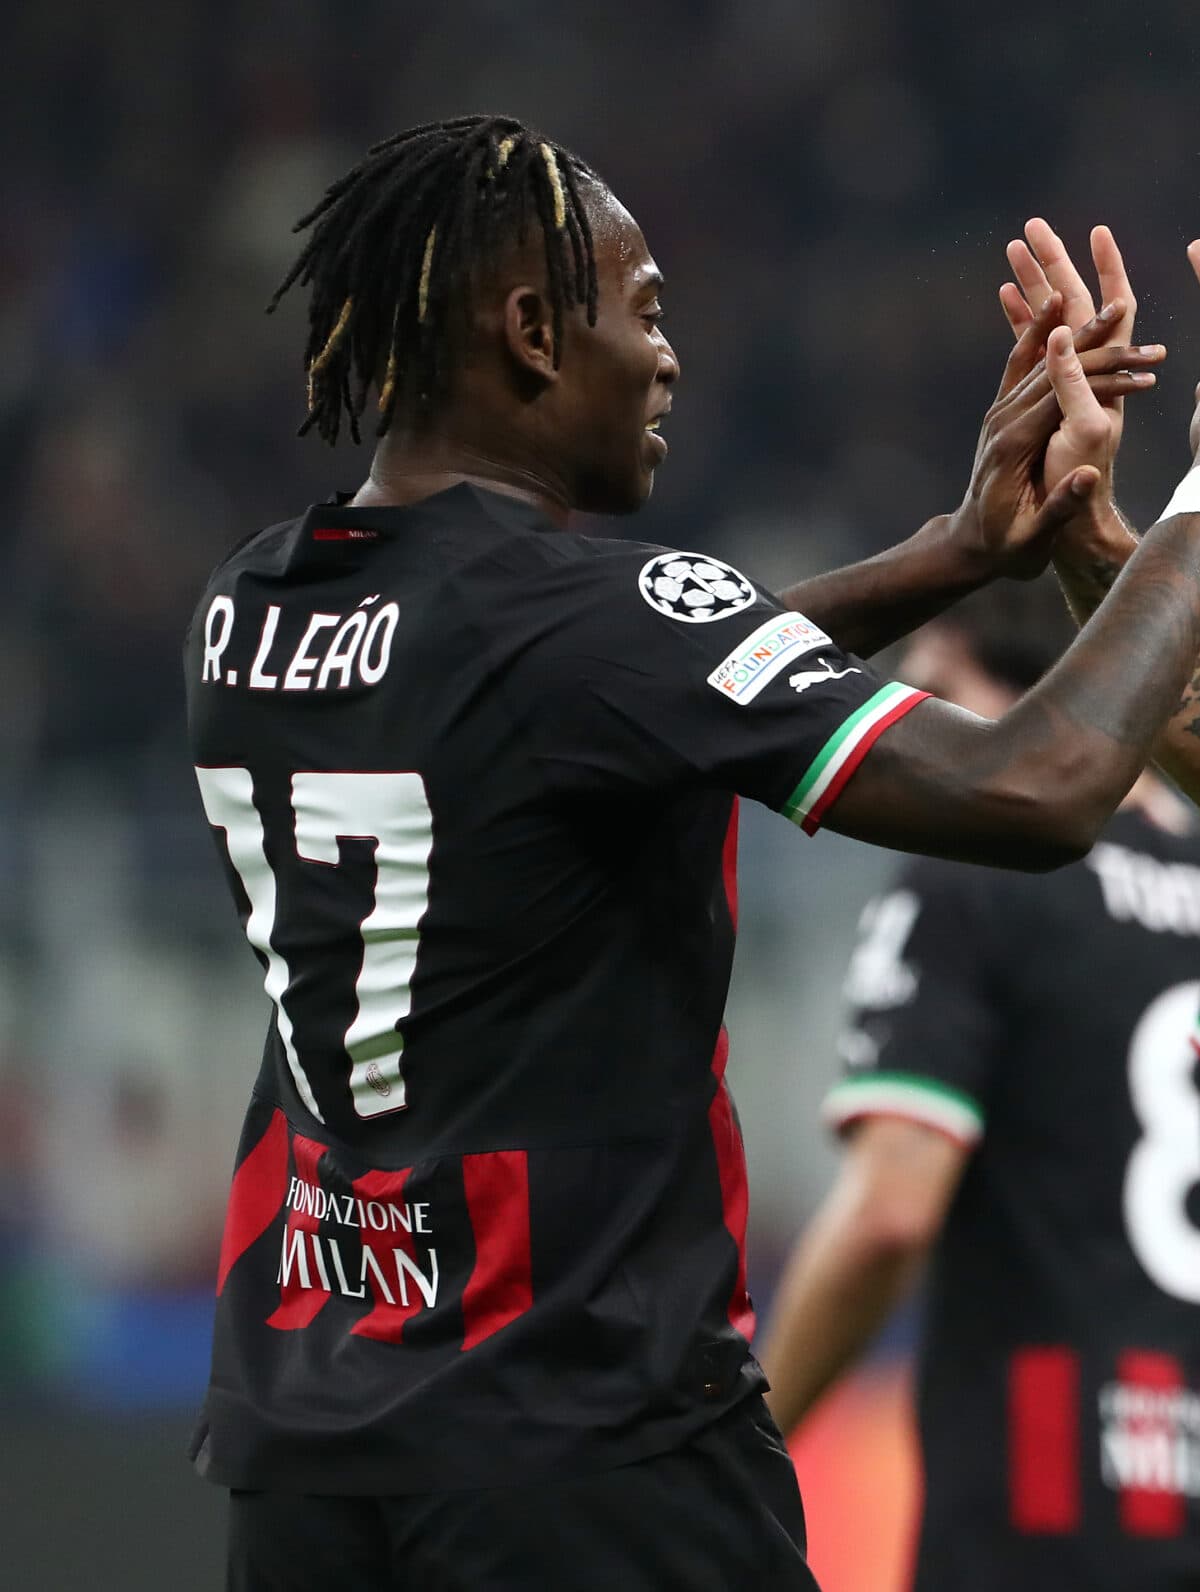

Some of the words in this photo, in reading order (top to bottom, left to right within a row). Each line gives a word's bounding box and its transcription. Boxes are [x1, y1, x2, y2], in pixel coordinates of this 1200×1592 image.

[712, 658, 738, 684] UEFA
[193, 764, 435, 1124] 17
[285, 1176, 433, 1234] FONDAZIONE
[276, 1223, 440, 1309] MILAN
